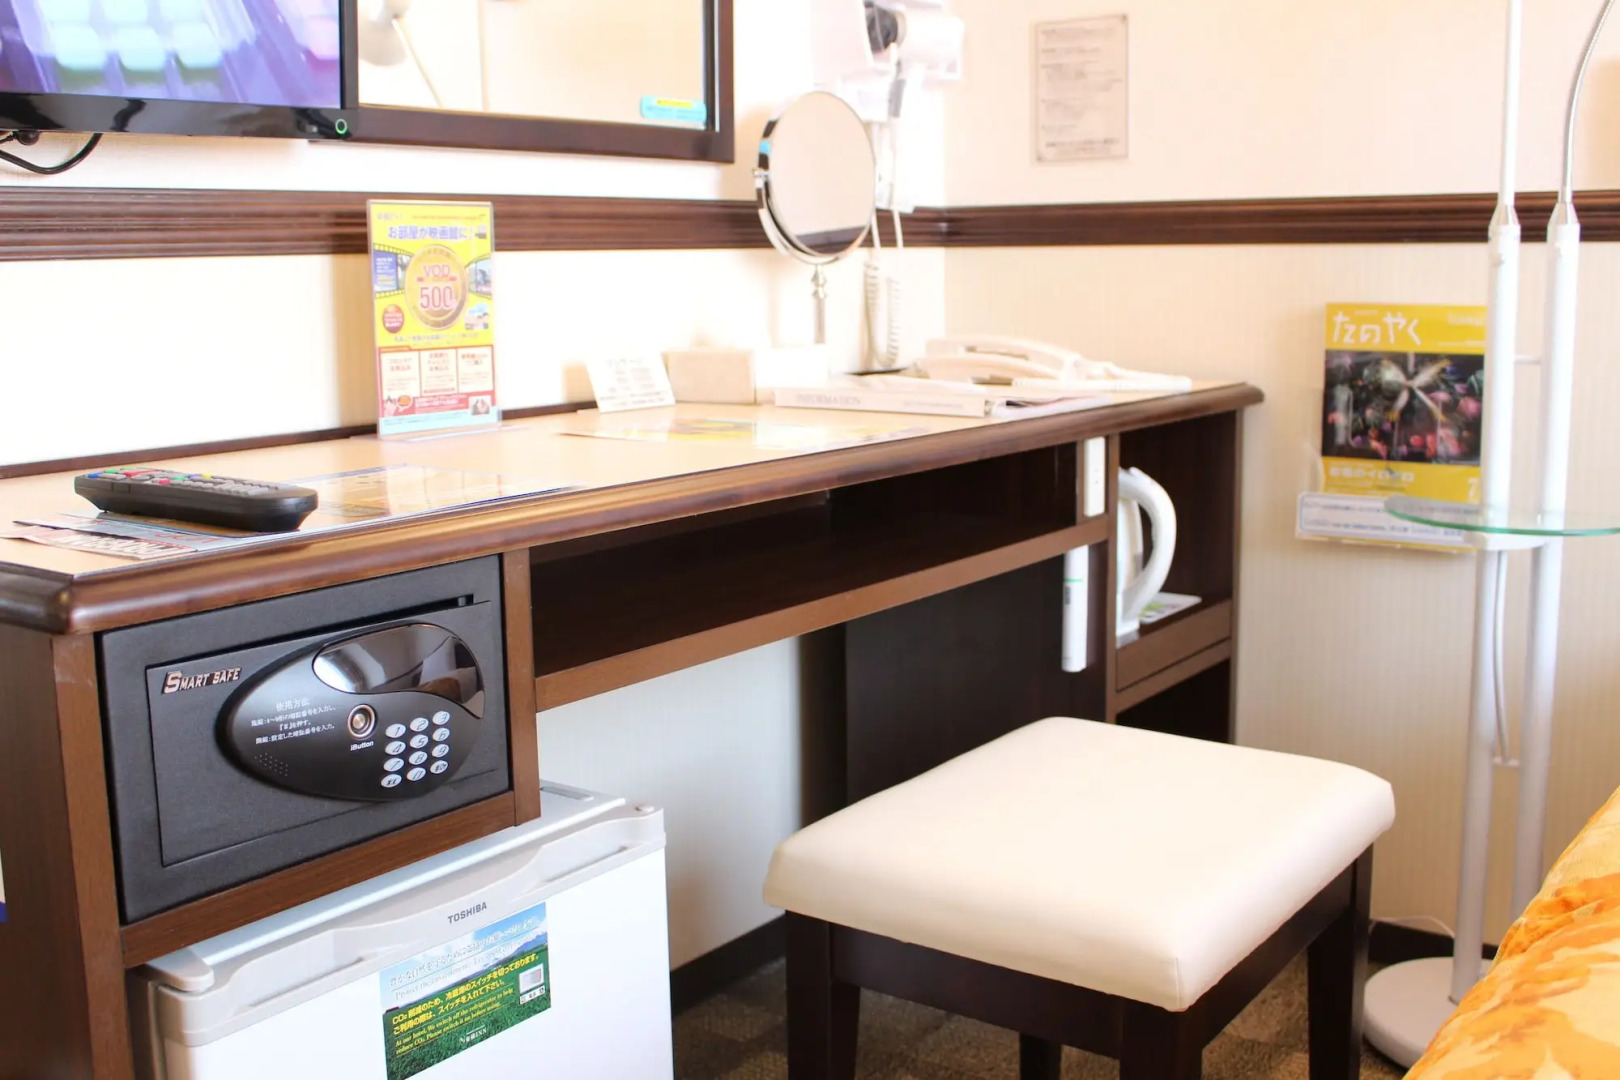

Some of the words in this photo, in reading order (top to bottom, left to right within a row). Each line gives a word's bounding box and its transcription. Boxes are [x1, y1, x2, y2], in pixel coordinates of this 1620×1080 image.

[422, 264, 451, 280] VOD
[419, 285, 454, 310] 500
[1332, 310, 1422, 346] たのやく
[164, 669, 210, 694] SMART
[211, 666, 242, 685] SAFE
[416, 719, 426, 730] 2
[350, 740, 374, 752] iButton
[391, 744, 402, 754] 4
[417, 736, 426, 747] 5
[438, 729, 447, 740] 6
[415, 753, 425, 763] 8
[438, 745, 447, 756] 9
[447, 901, 488, 924] TOSHIBA
